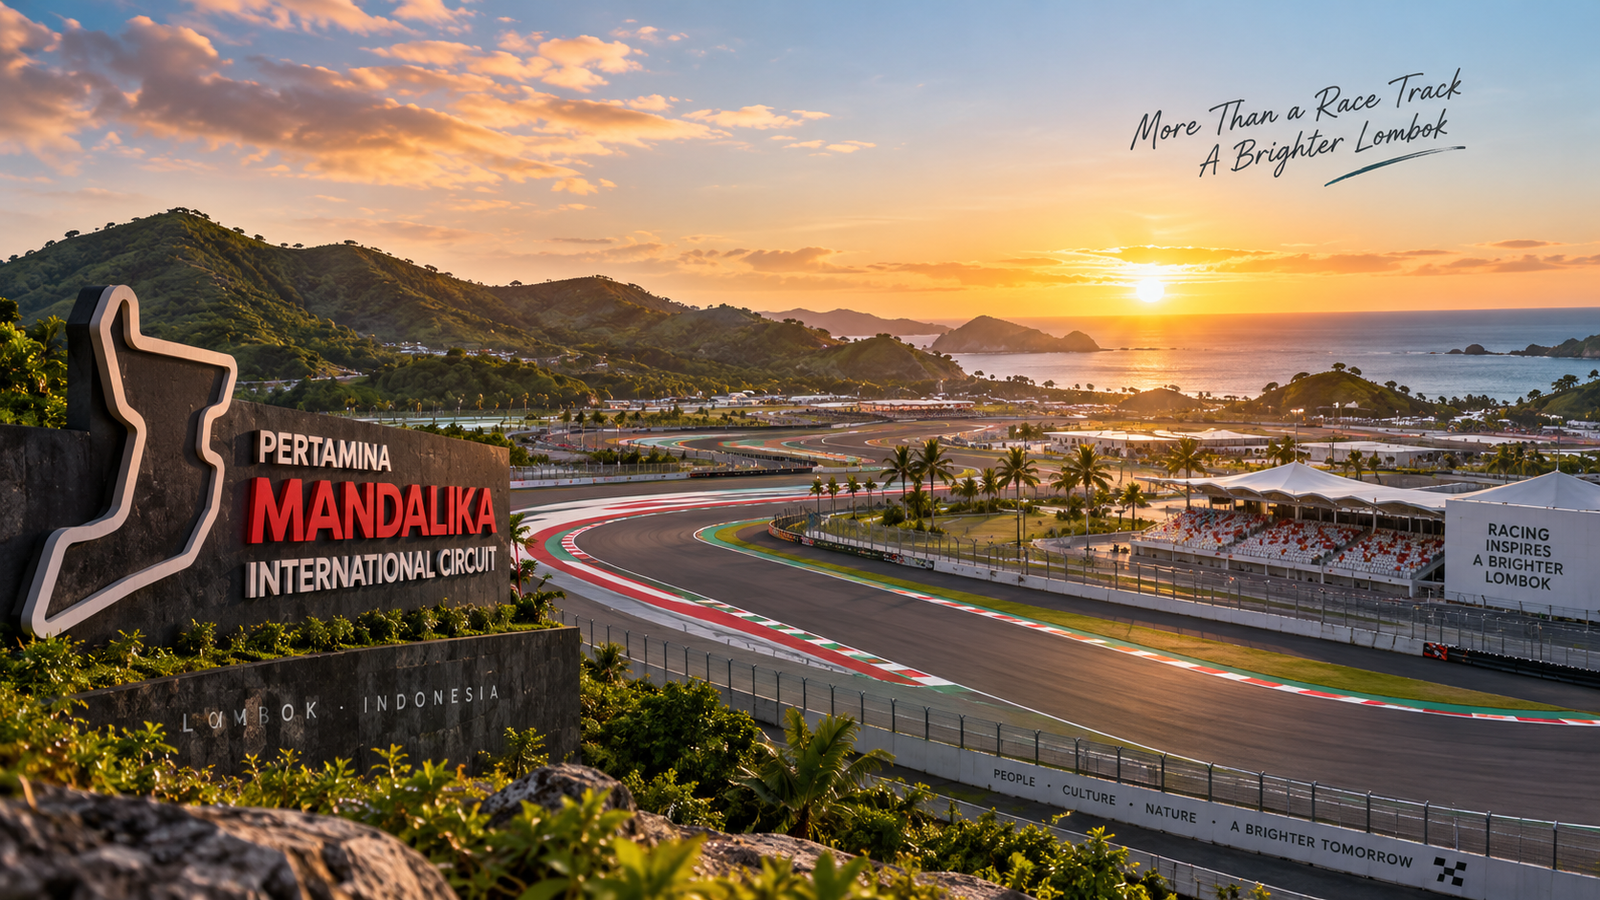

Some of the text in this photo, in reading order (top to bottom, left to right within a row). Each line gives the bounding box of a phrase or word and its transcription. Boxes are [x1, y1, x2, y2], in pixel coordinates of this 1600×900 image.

[254, 429, 392, 472] PERTAMINA
[246, 476, 498, 545] MANDALIKA
[1488, 522, 1550, 542] RACING
[1472, 554, 1564, 576] A BRIGHTER
[1486, 539, 1552, 558] INSPIRES
[244, 545, 497, 599] INTERNATIONAL CIRCUIT
[1485, 570, 1551, 591] LOMBOK
[182, 685, 499, 733] LOMBOK INDONESIA
[993, 768, 1413, 869] PEOPLE CULTURE NATURE A BRIGHTER TOMORROW
